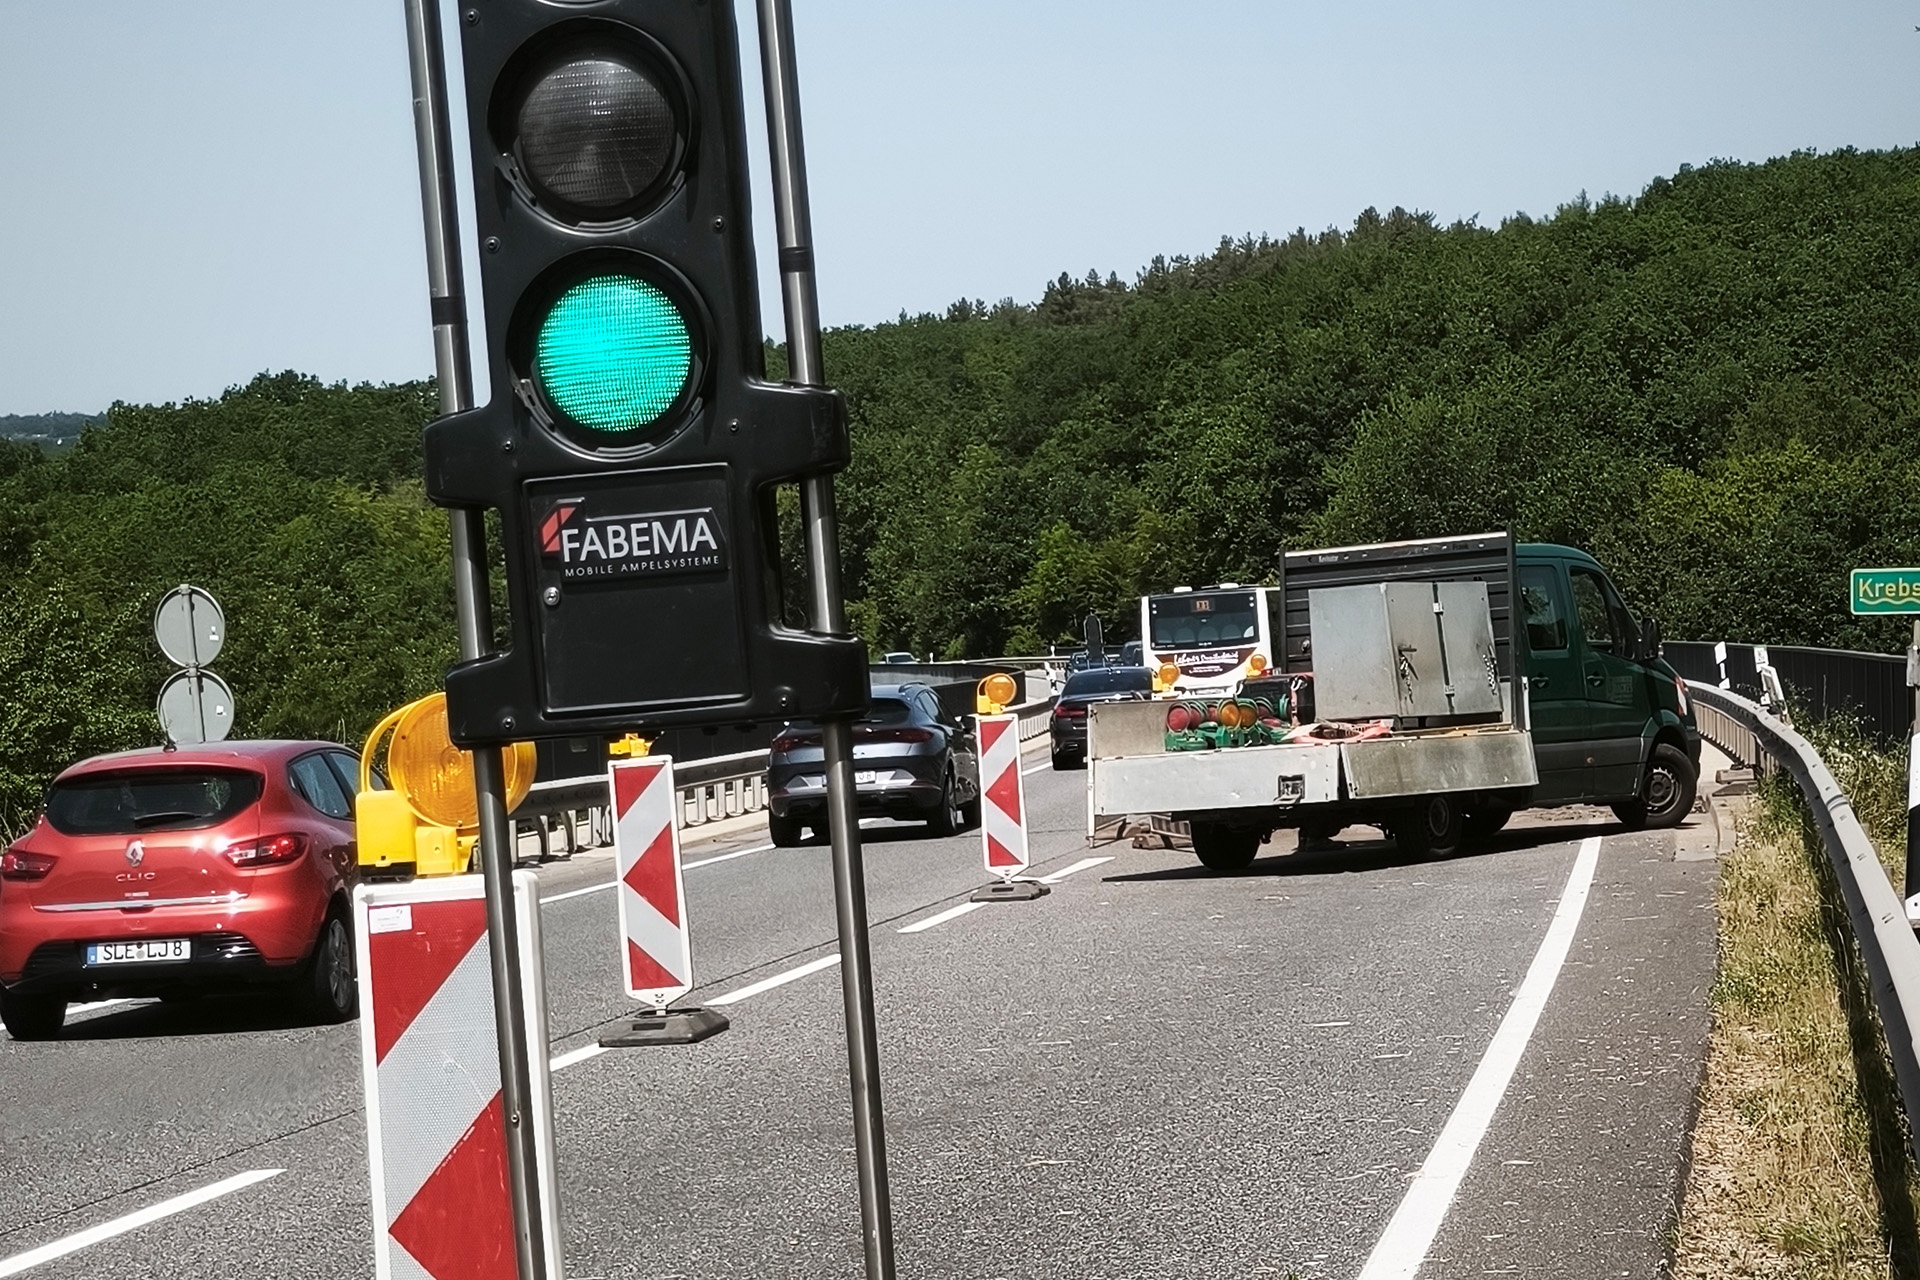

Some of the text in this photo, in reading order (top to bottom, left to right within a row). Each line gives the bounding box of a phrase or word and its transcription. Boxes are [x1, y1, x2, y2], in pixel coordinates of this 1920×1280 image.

[561, 517, 718, 562] FABEMA
[565, 556, 719, 577] MOBILE AMPELSYSTEME
[1859, 577, 1920, 597] Krebs
[103, 944, 134, 960] SLE
